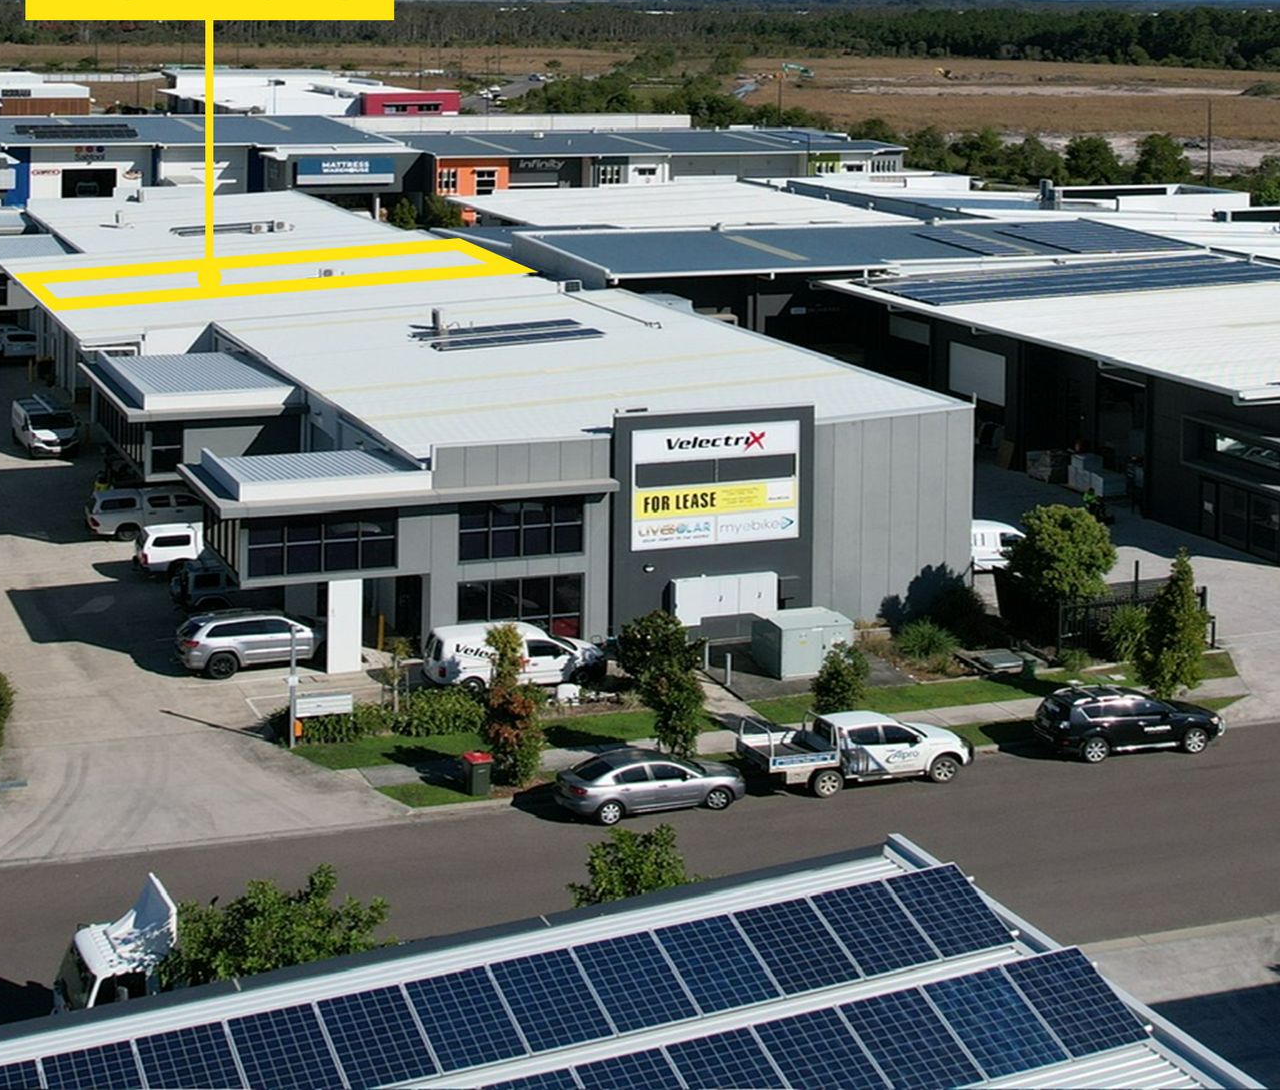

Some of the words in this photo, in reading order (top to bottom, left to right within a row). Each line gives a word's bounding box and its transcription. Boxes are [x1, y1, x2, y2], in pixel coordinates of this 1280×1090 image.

[321, 160, 370, 168] MATTRESS
[643, 495, 670, 514] FOR
[675, 491, 717, 511] LEASE
